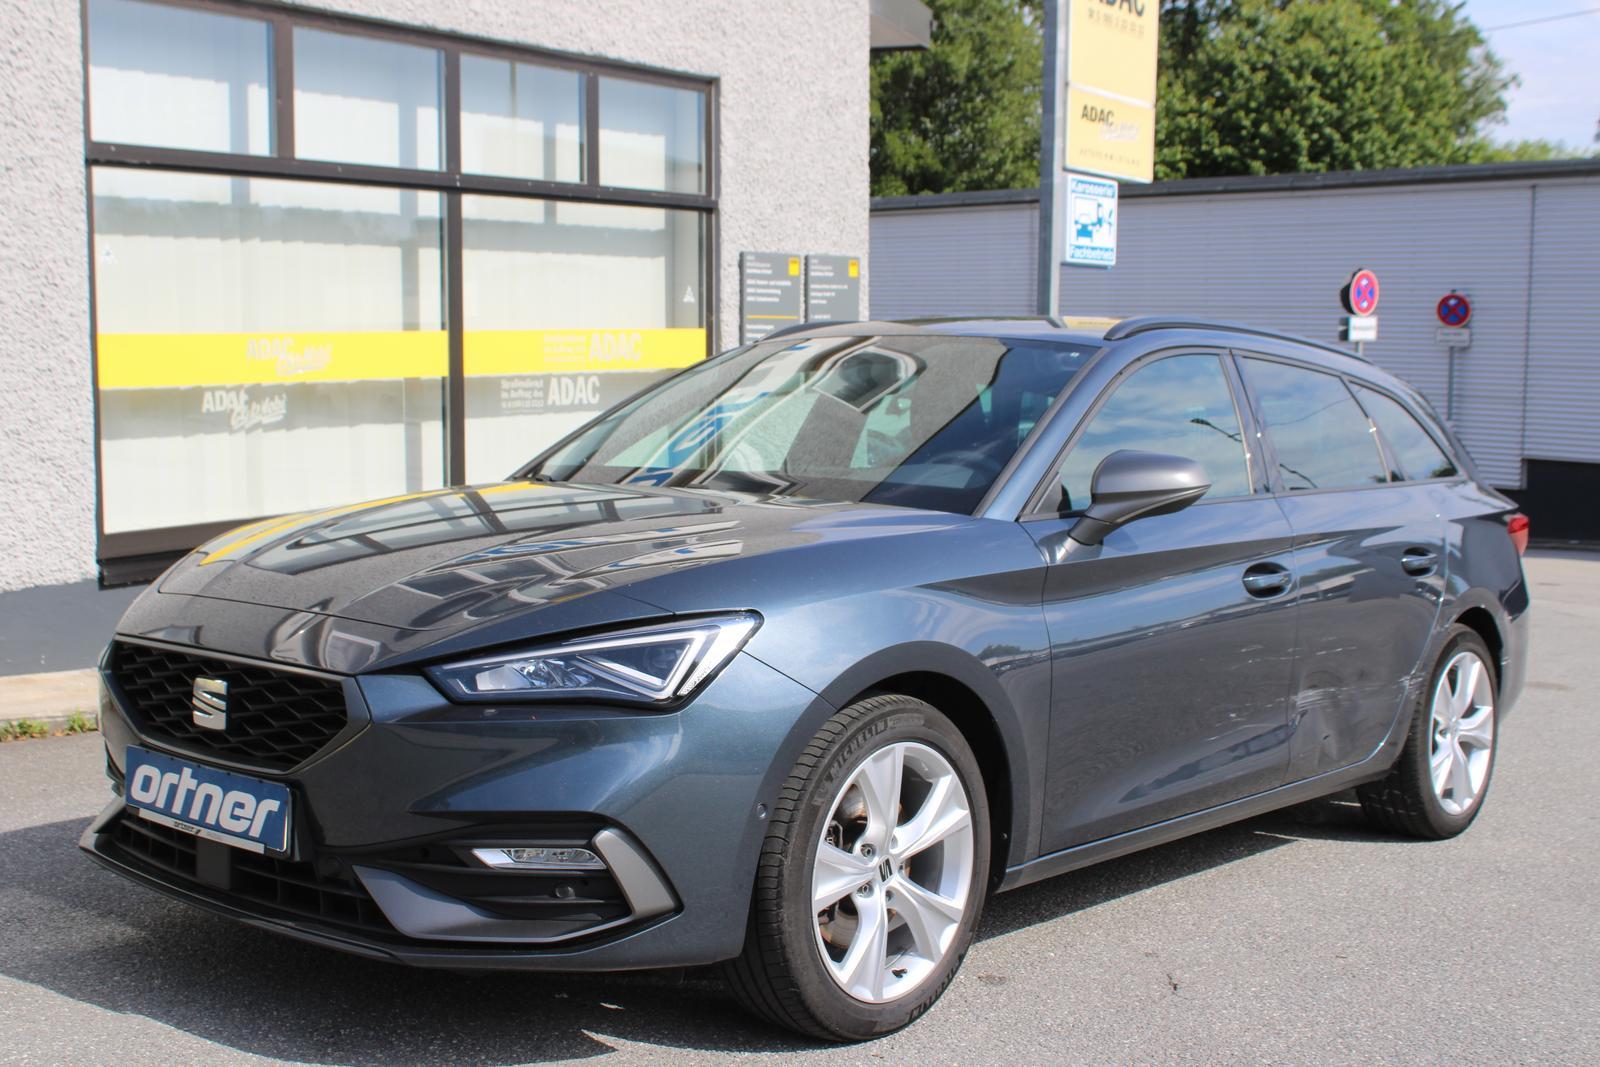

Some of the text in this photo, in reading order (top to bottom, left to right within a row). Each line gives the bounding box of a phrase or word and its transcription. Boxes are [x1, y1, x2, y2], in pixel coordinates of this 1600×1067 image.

[1081, 104, 1115, 127] ADAC
[589, 332, 641, 360] ADAC
[547, 375, 601, 406] ADAC
[130, 764, 281, 839] ortner
